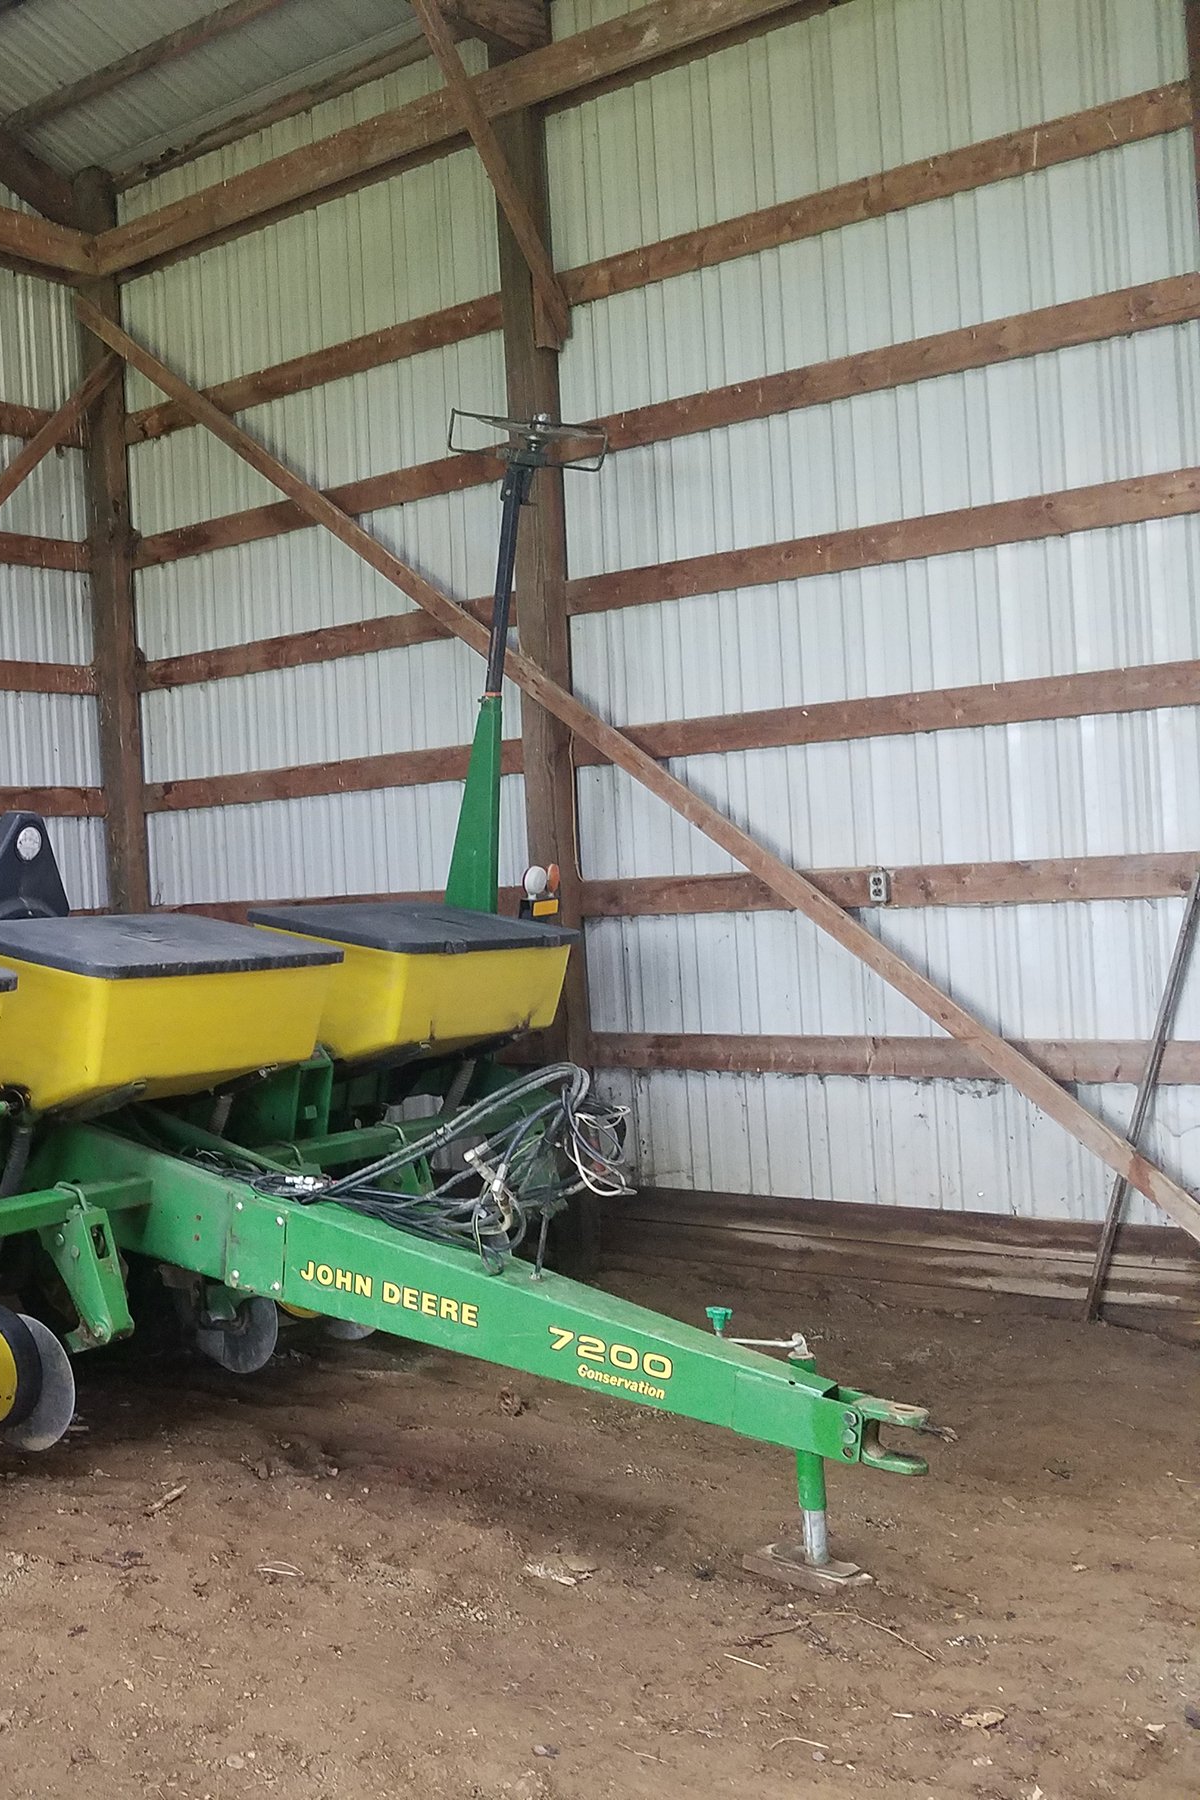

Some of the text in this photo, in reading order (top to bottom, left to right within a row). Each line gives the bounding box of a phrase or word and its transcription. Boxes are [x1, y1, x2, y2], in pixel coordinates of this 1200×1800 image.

[300, 1260, 479, 1328] JOHN DEERE
[548, 1326, 673, 1380] 7200
[577, 1363, 665, 1400] Conservation
